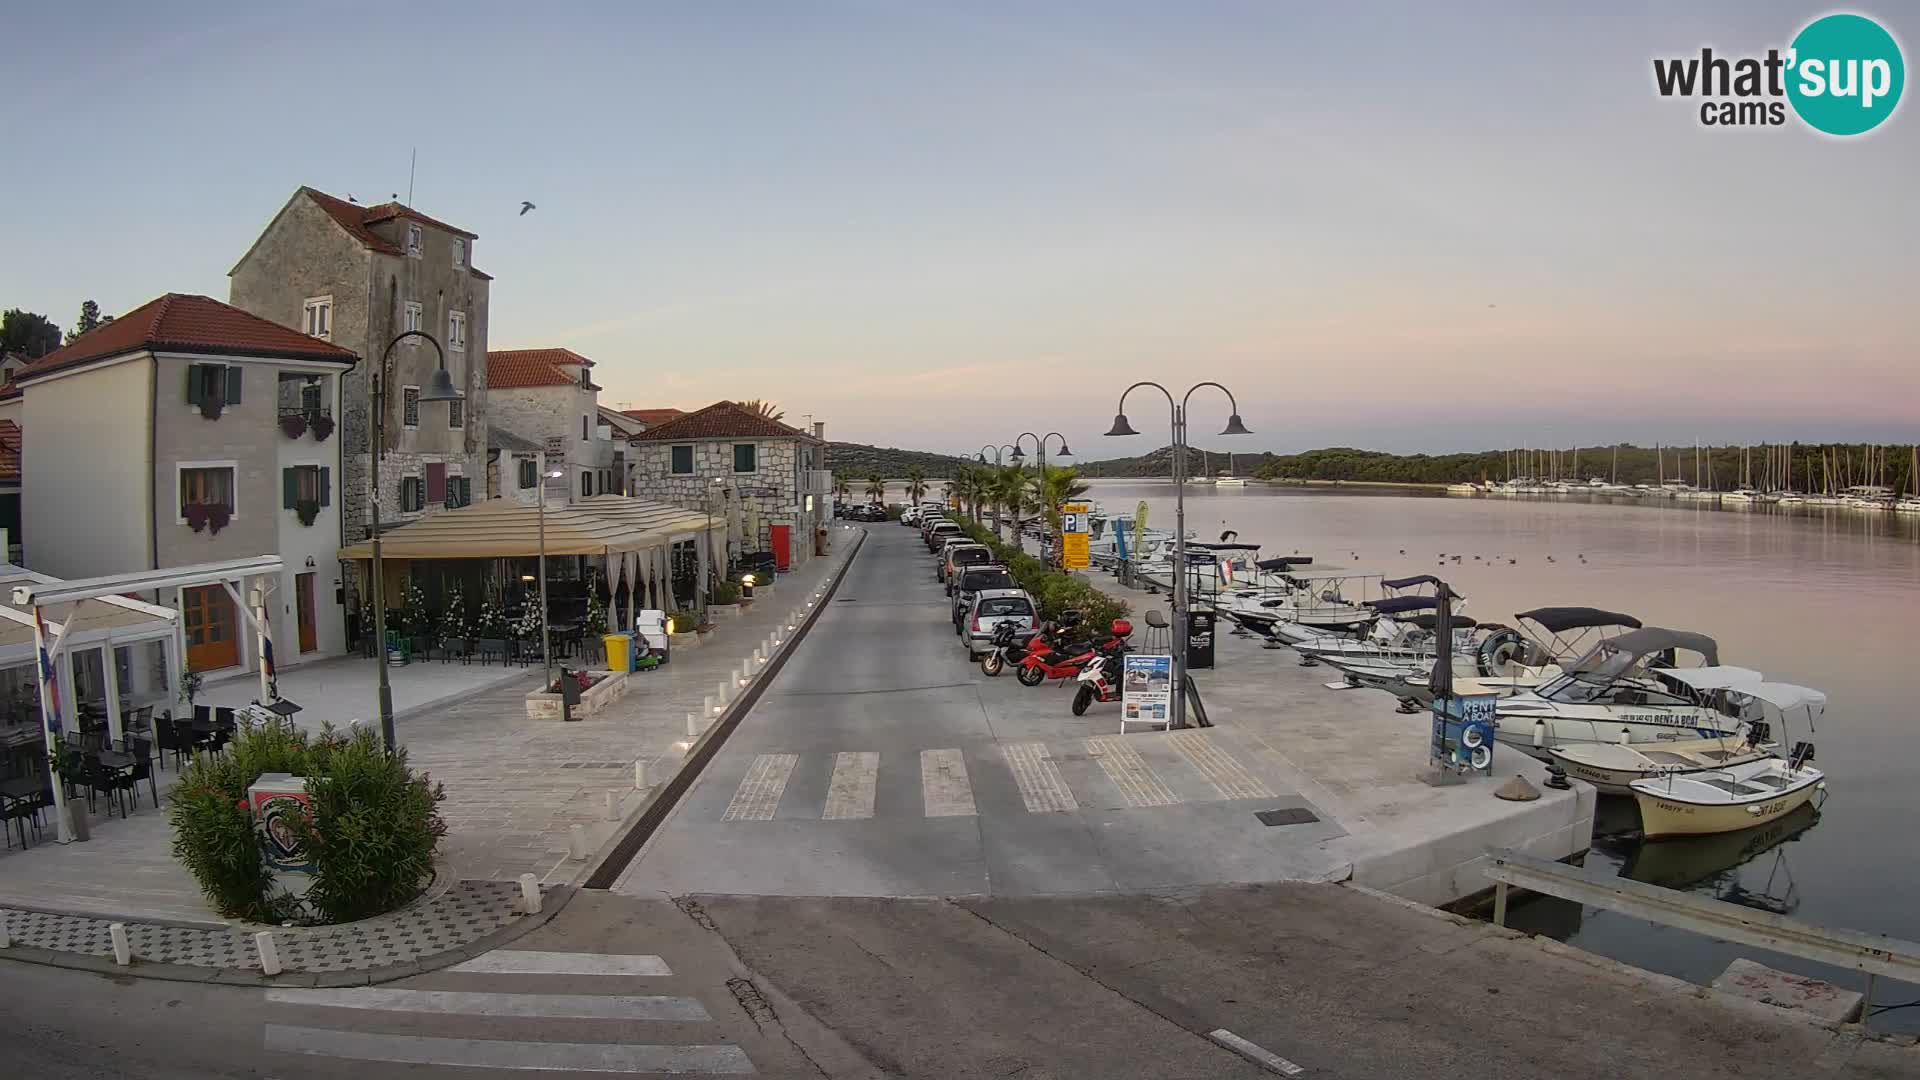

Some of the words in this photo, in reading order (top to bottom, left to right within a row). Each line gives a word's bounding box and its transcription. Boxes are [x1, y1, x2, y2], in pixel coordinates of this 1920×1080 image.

[1065, 515, 1075, 530] P
[1463, 701, 1495, 712] RENT
[1463, 714, 1470, 722] A
[1471, 712, 1494, 722] BOAT
[1654, 714, 1673, 724] RENT
[1674, 715, 1680, 724] A
[1681, 715, 1699, 726] BOAT
